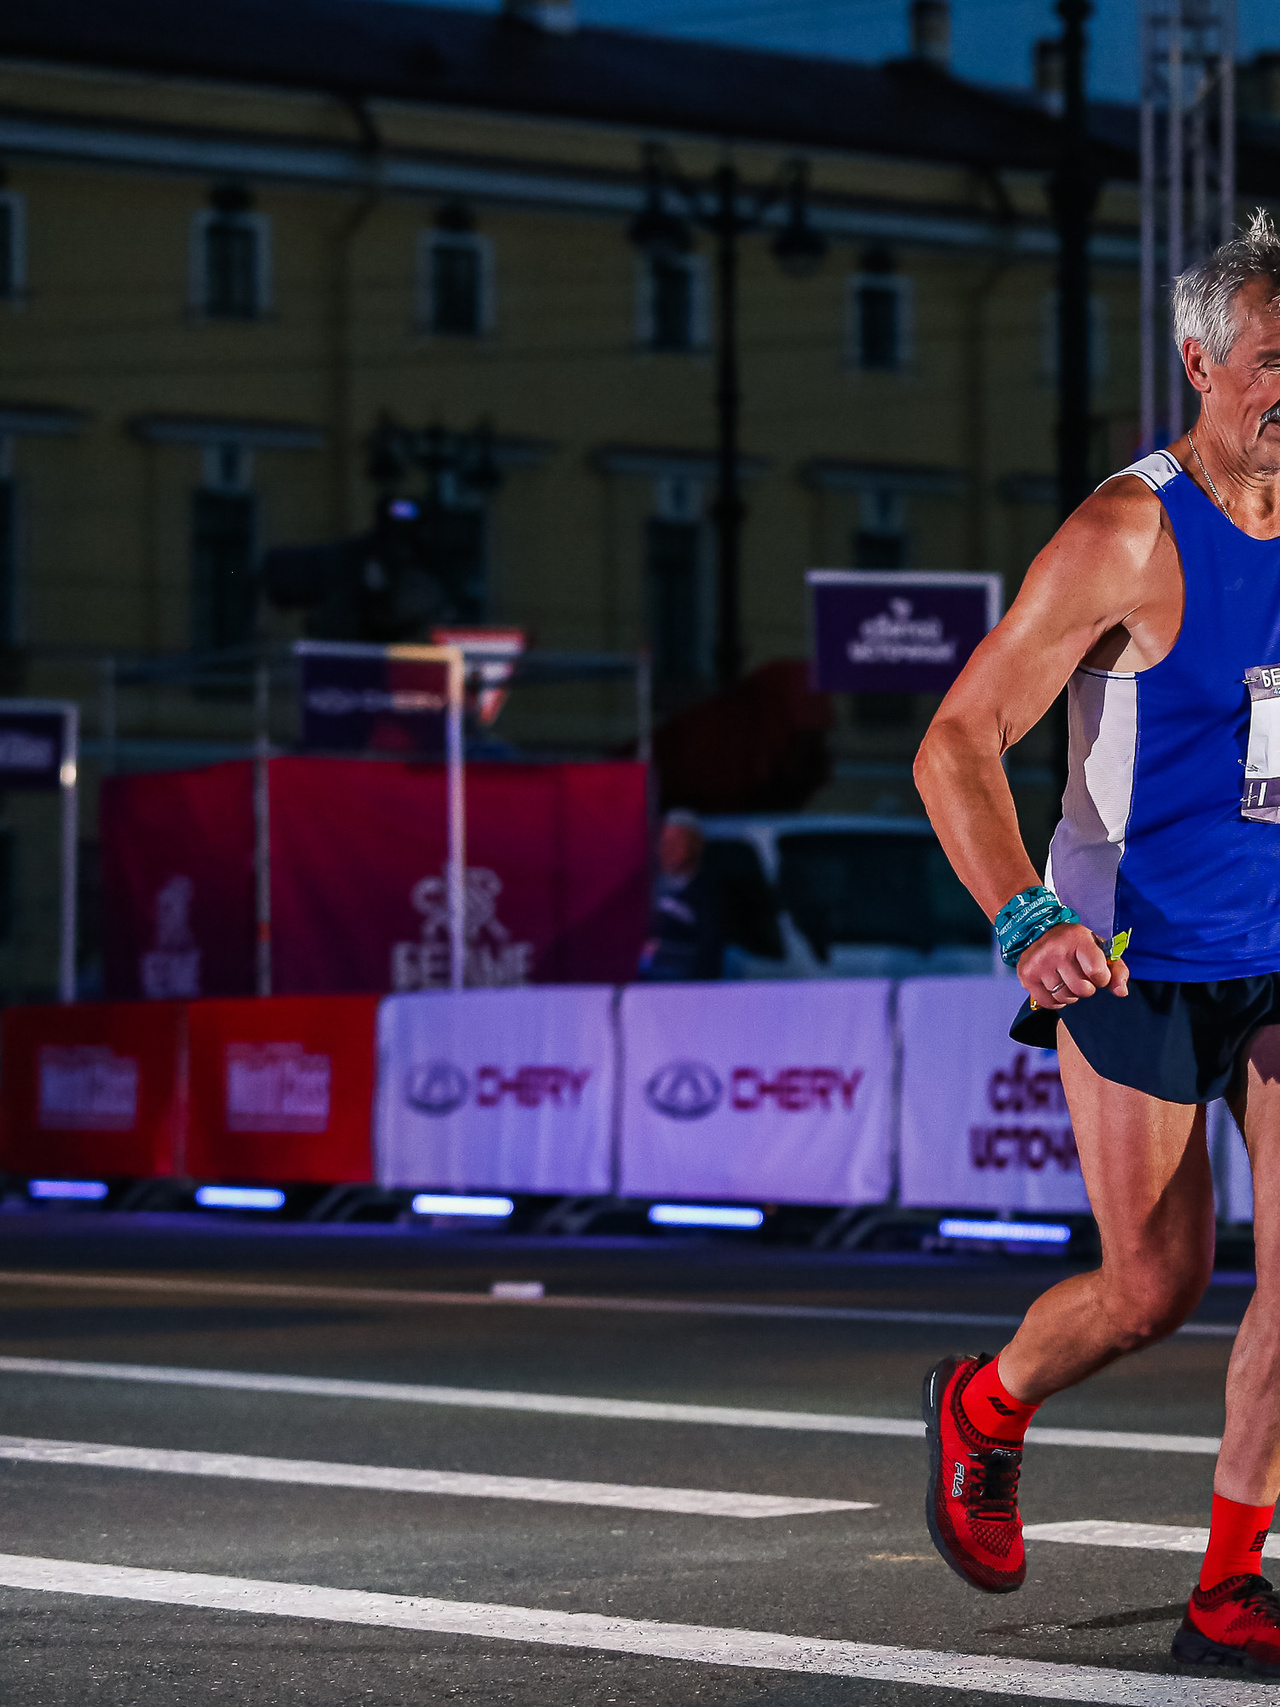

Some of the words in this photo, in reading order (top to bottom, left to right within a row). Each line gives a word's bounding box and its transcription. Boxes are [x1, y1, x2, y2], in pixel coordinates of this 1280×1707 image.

[477, 1066, 592, 1108] CHERY
[732, 1067, 863, 1111] CHERY
[987, 1052, 1069, 1114] свят
[951, 1461, 965, 1498] FILA
